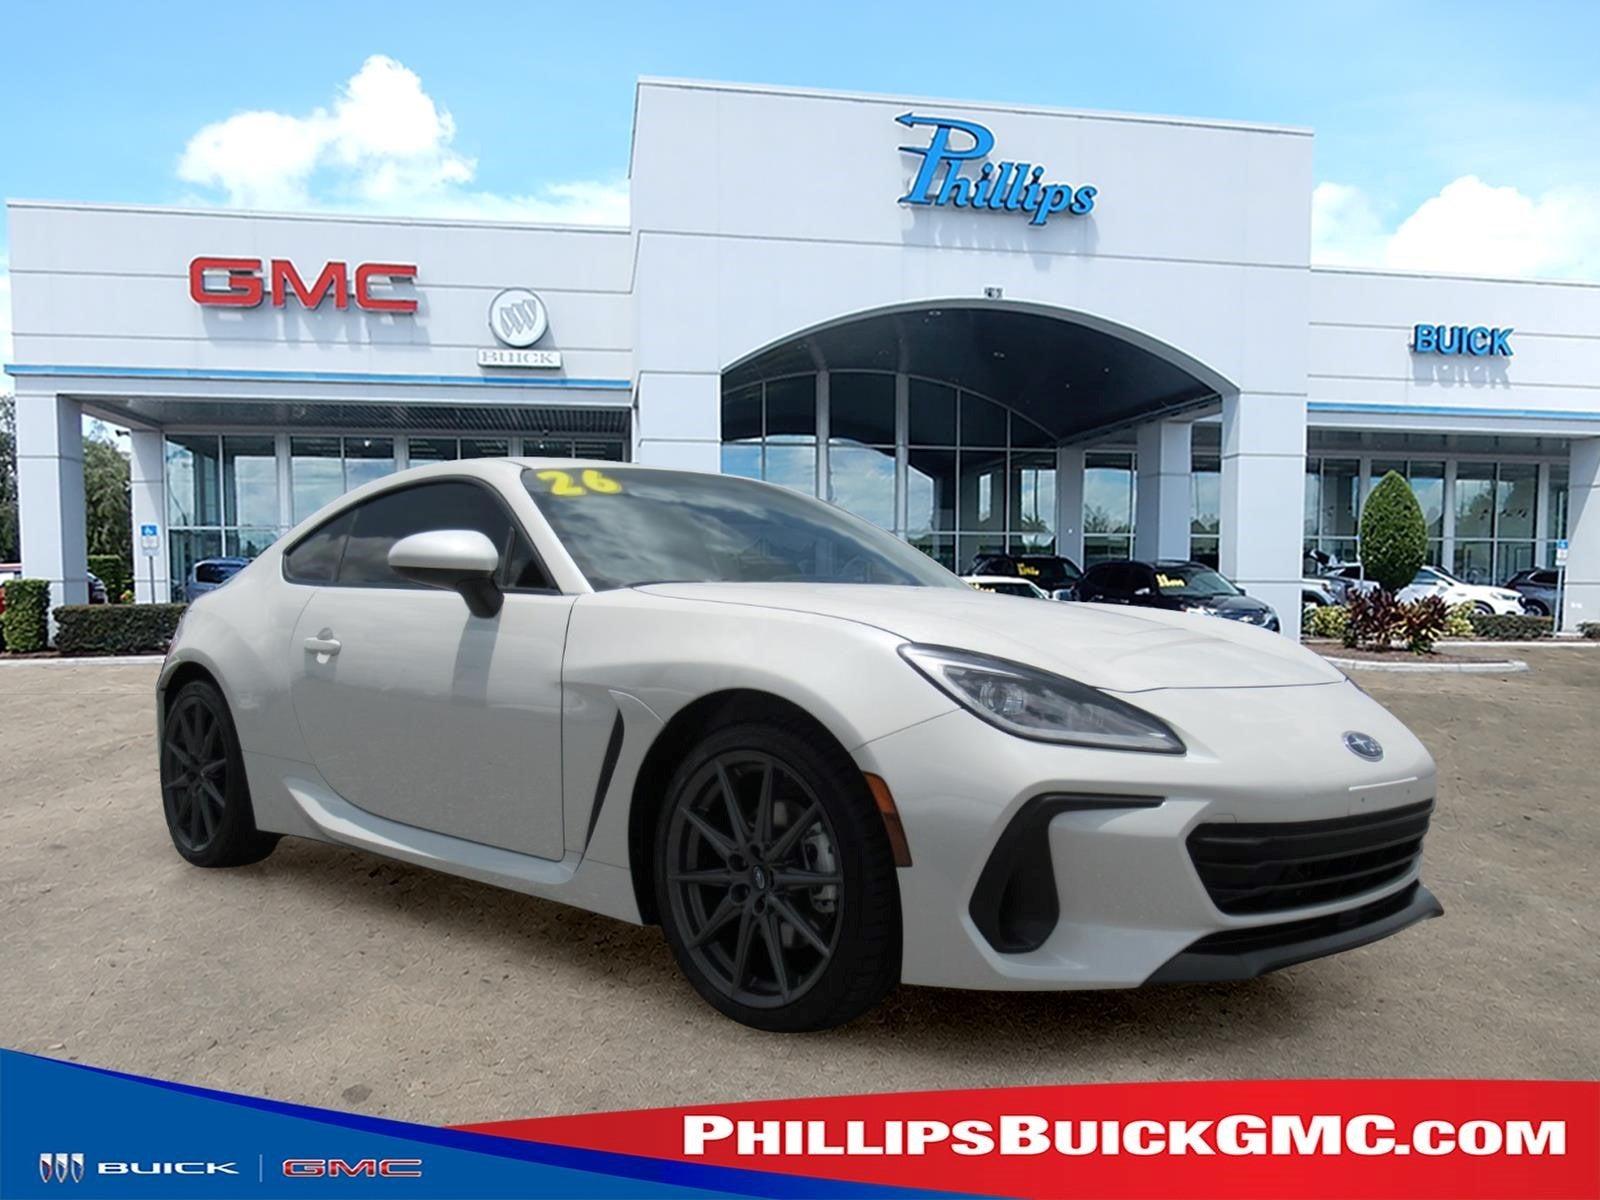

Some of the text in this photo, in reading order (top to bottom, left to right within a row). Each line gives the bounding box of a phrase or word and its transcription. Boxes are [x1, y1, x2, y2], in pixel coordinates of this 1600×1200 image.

[895, 112, 1098, 226] Phillips
[189, 256, 418, 315] GMC
[1413, 323, 1515, 356] BUICK
[482, 351, 555, 364] BUICK
[536, 469, 622, 496] 26
